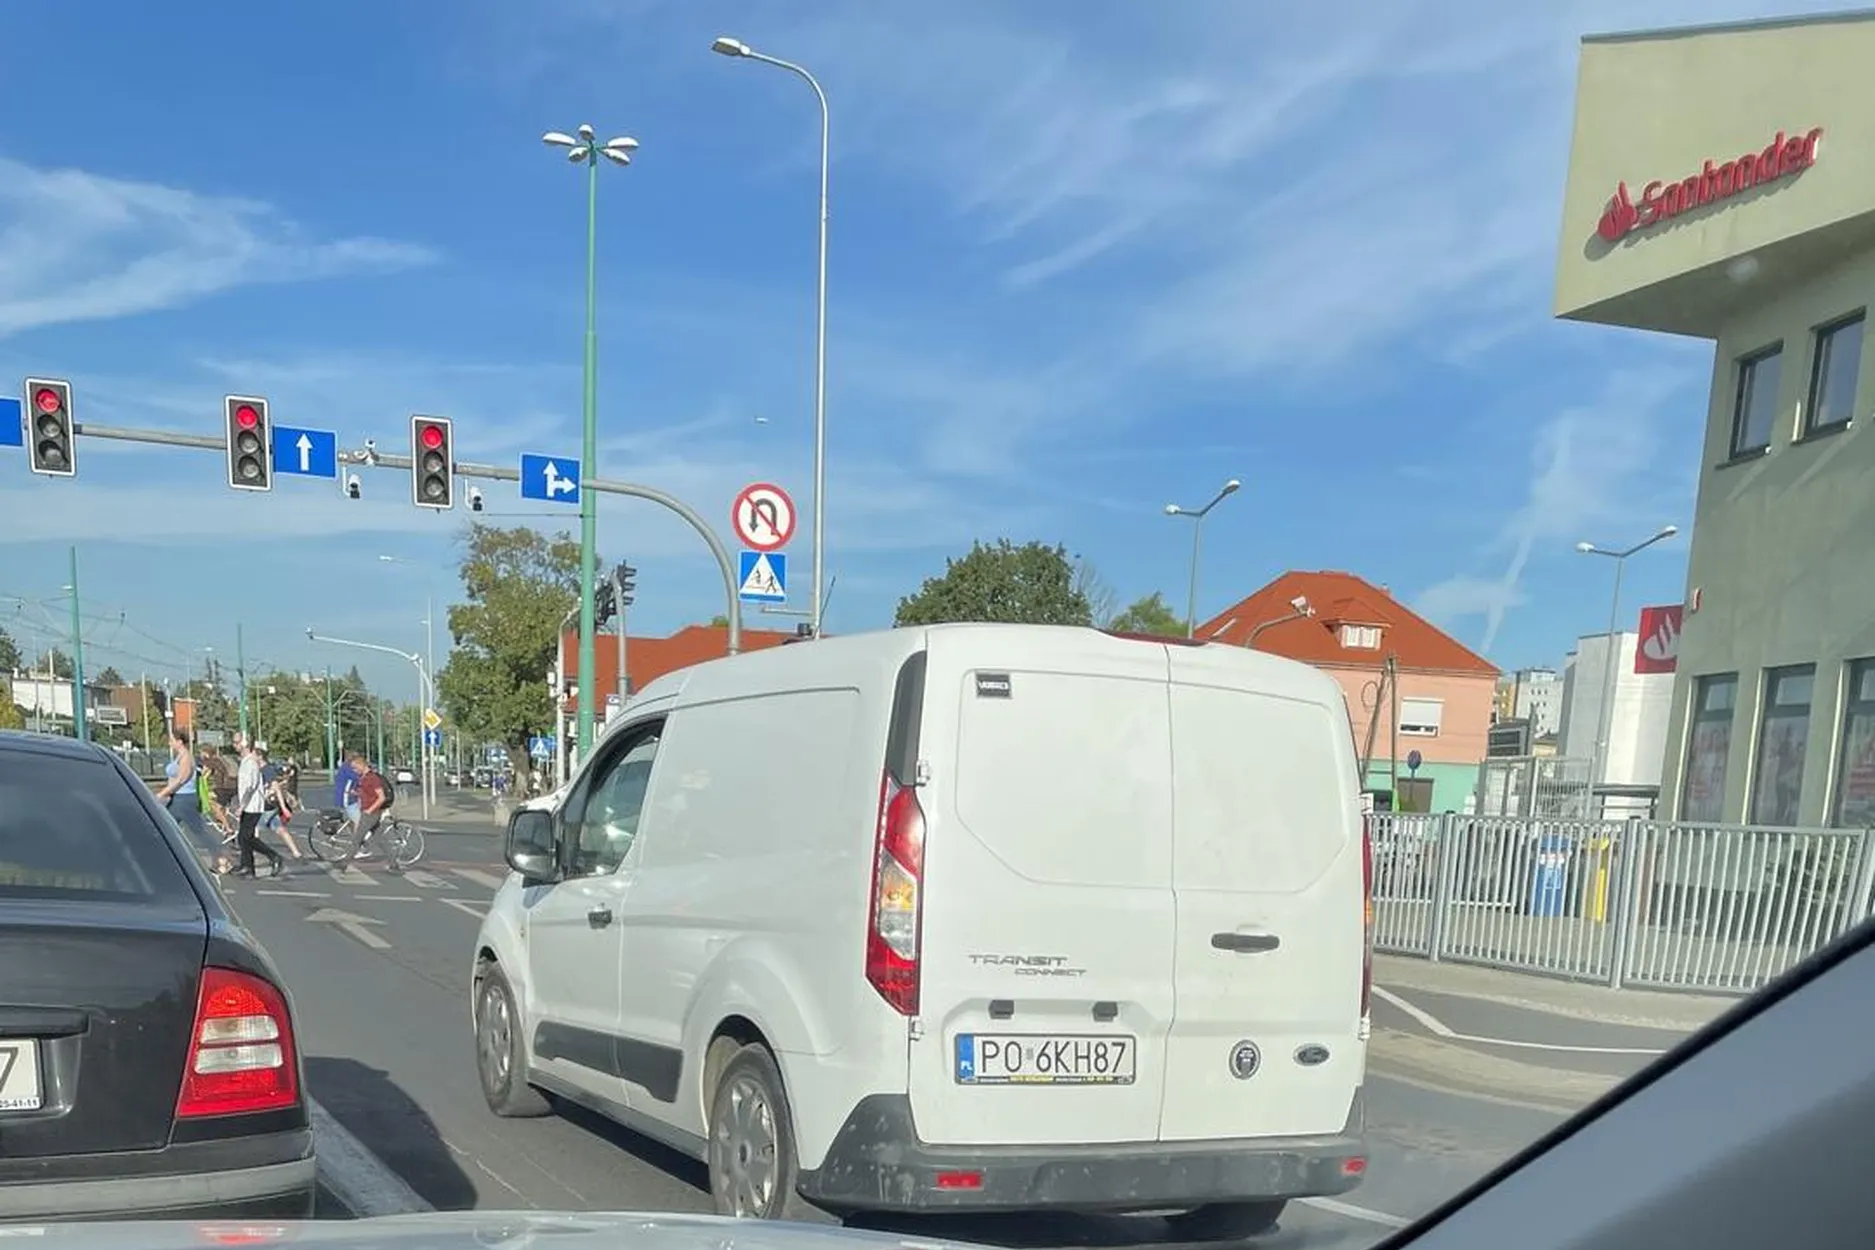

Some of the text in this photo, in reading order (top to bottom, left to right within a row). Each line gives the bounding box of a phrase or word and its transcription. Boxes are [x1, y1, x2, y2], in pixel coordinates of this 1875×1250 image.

[1635, 127, 1823, 227] Santander
[968, 954, 1068, 966] TRANSIT
[1014, 967, 1087, 977] CONNECT
[981, 1040, 1126, 1073] PO 6KH87
